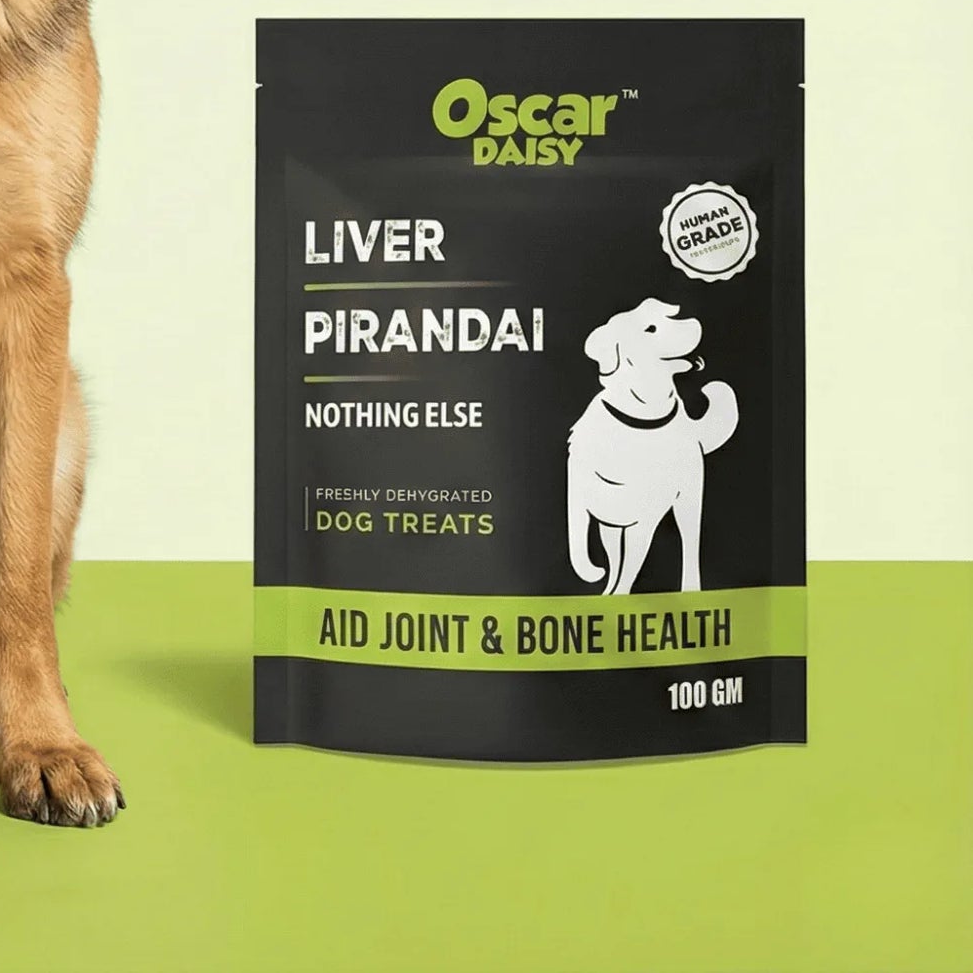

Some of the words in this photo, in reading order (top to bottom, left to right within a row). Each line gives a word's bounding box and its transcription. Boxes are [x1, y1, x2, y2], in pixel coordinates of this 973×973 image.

[432, 78, 618, 138] Oscar
[473, 136, 583, 166] DAISY
[676, 216, 744, 251] GRADE
[680, 206, 729, 231] HUMAN
[305, 218, 445, 264] LIVER
[305, 307, 544, 353] PIRANDAI
[305, 402, 419, 428] NOTHING
[426, 402, 483, 427] ELSE
[315, 487, 381, 502] FRESHLY
[316, 511, 374, 533] DOG
[384, 512, 494, 535] TREATS
[319, 608, 369, 647] AID
[379, 612, 469, 654] JOINT
[481, 615, 505, 654] &
[518, 614, 604, 655] BONE
[618, 608, 731, 652] HEALTH
[668, 680, 707, 711] 100
[712, 677, 744, 707] GM
